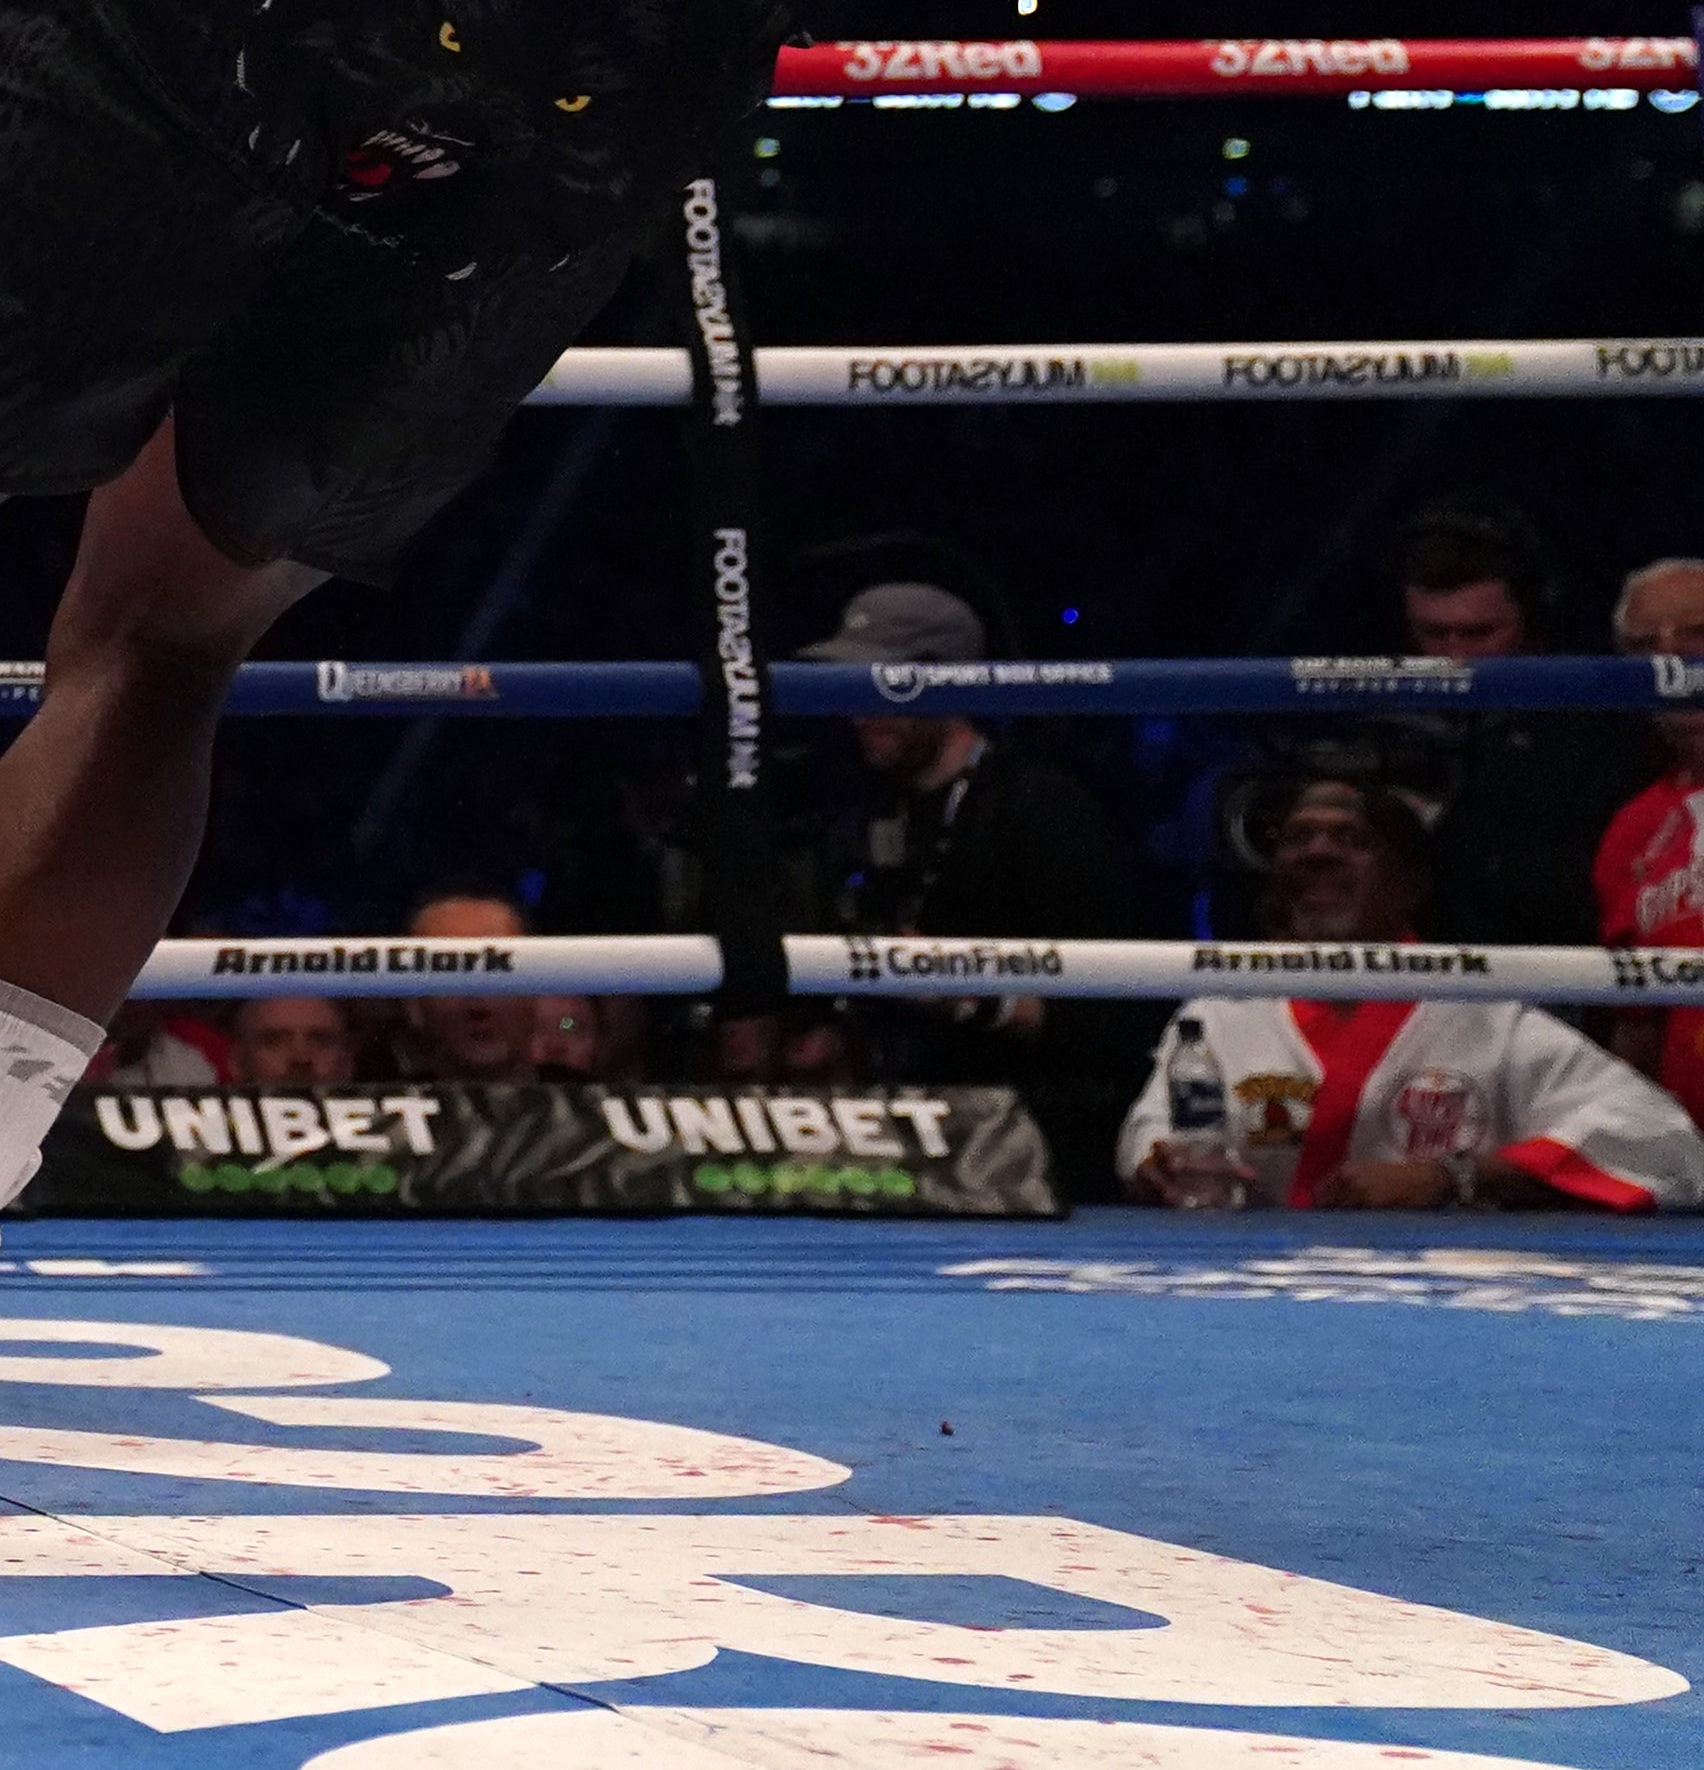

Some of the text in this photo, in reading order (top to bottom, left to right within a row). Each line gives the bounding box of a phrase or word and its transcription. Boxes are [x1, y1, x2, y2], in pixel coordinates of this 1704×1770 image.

[843, 41, 1043, 81] 32Red
[214, 946, 515, 974] Arnold Clark
[887, 947, 1063, 977] CoinField
[1193, 948, 1490, 973] Arnold Clark
[94, 1096, 441, 1157] UNIBET
[599, 1098, 951, 1158] UNIBET
